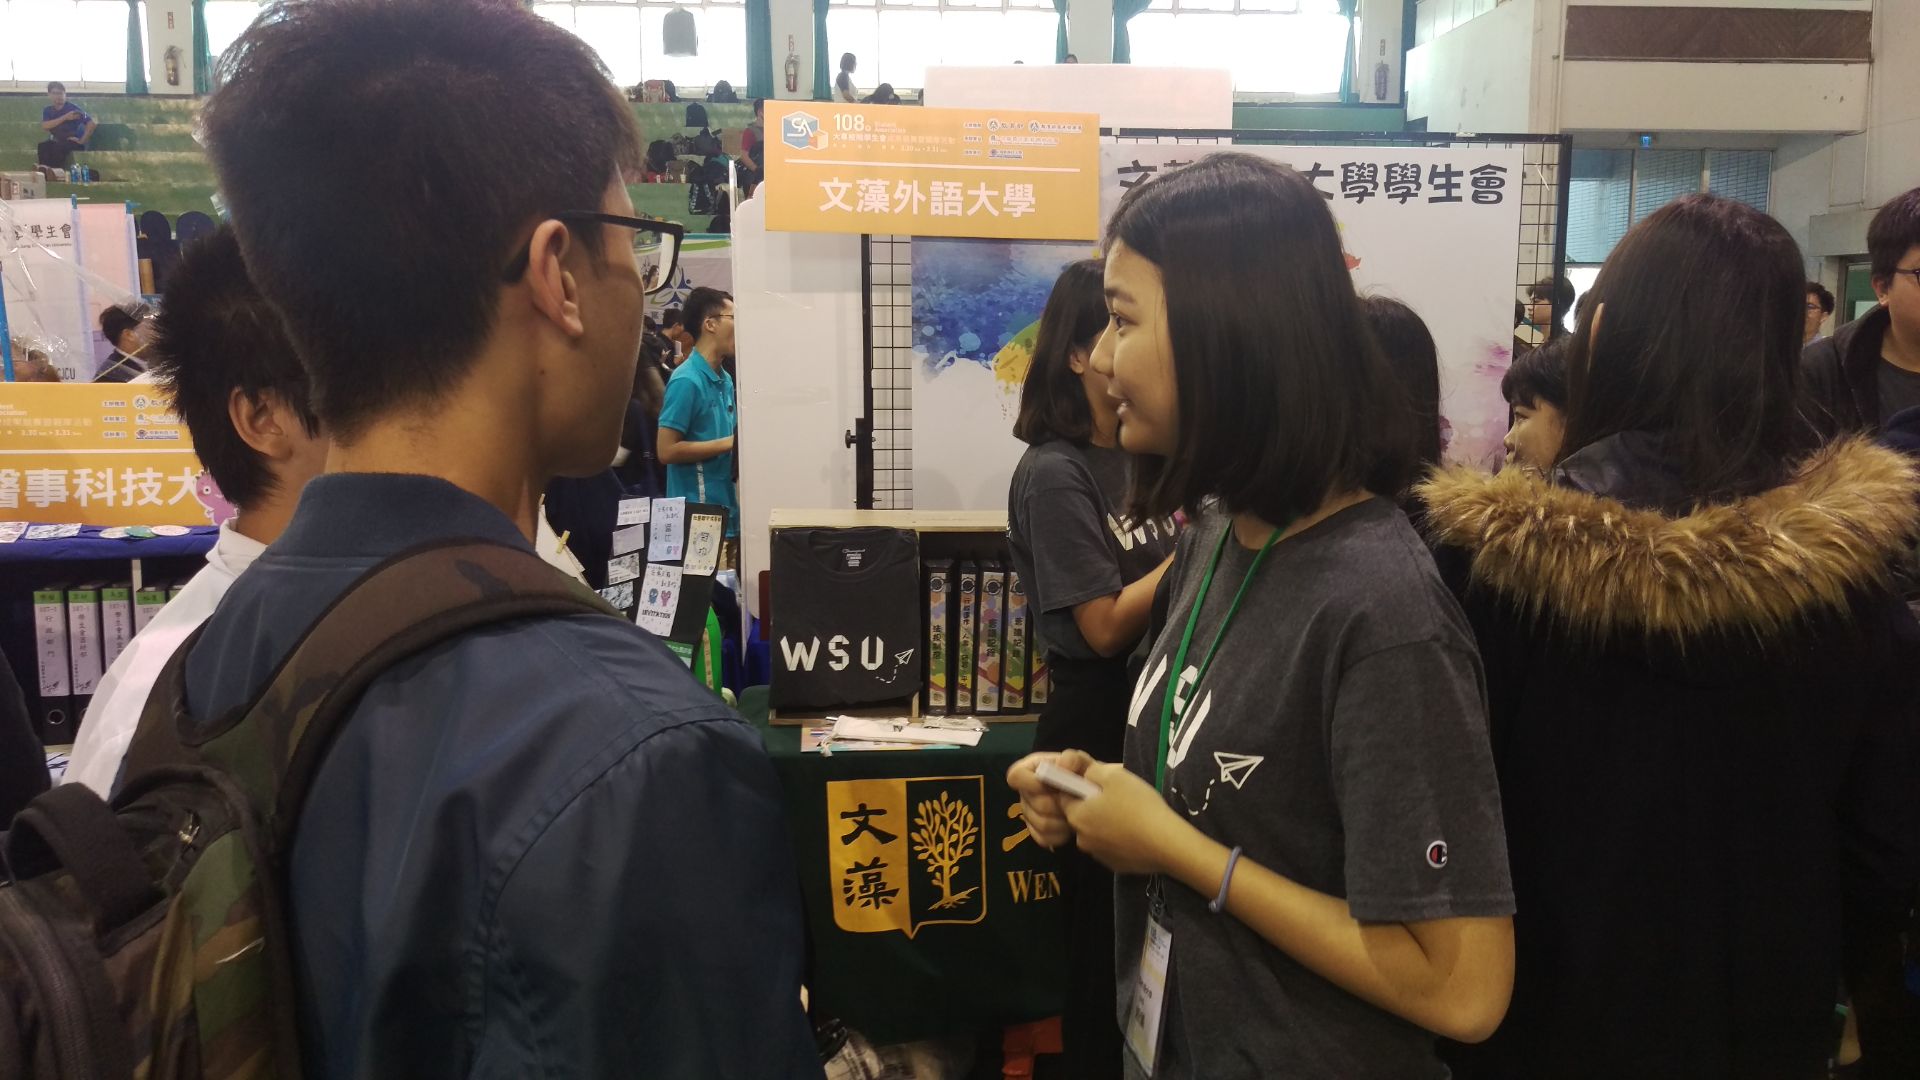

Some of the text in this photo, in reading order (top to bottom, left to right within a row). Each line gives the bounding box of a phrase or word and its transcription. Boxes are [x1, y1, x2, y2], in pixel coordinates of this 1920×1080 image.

[833, 114, 865, 131] 108
[818, 177, 1036, 218] 文藻外語大學
[780, 635, 884, 671] WSU
[840, 803, 901, 910] 文藻
